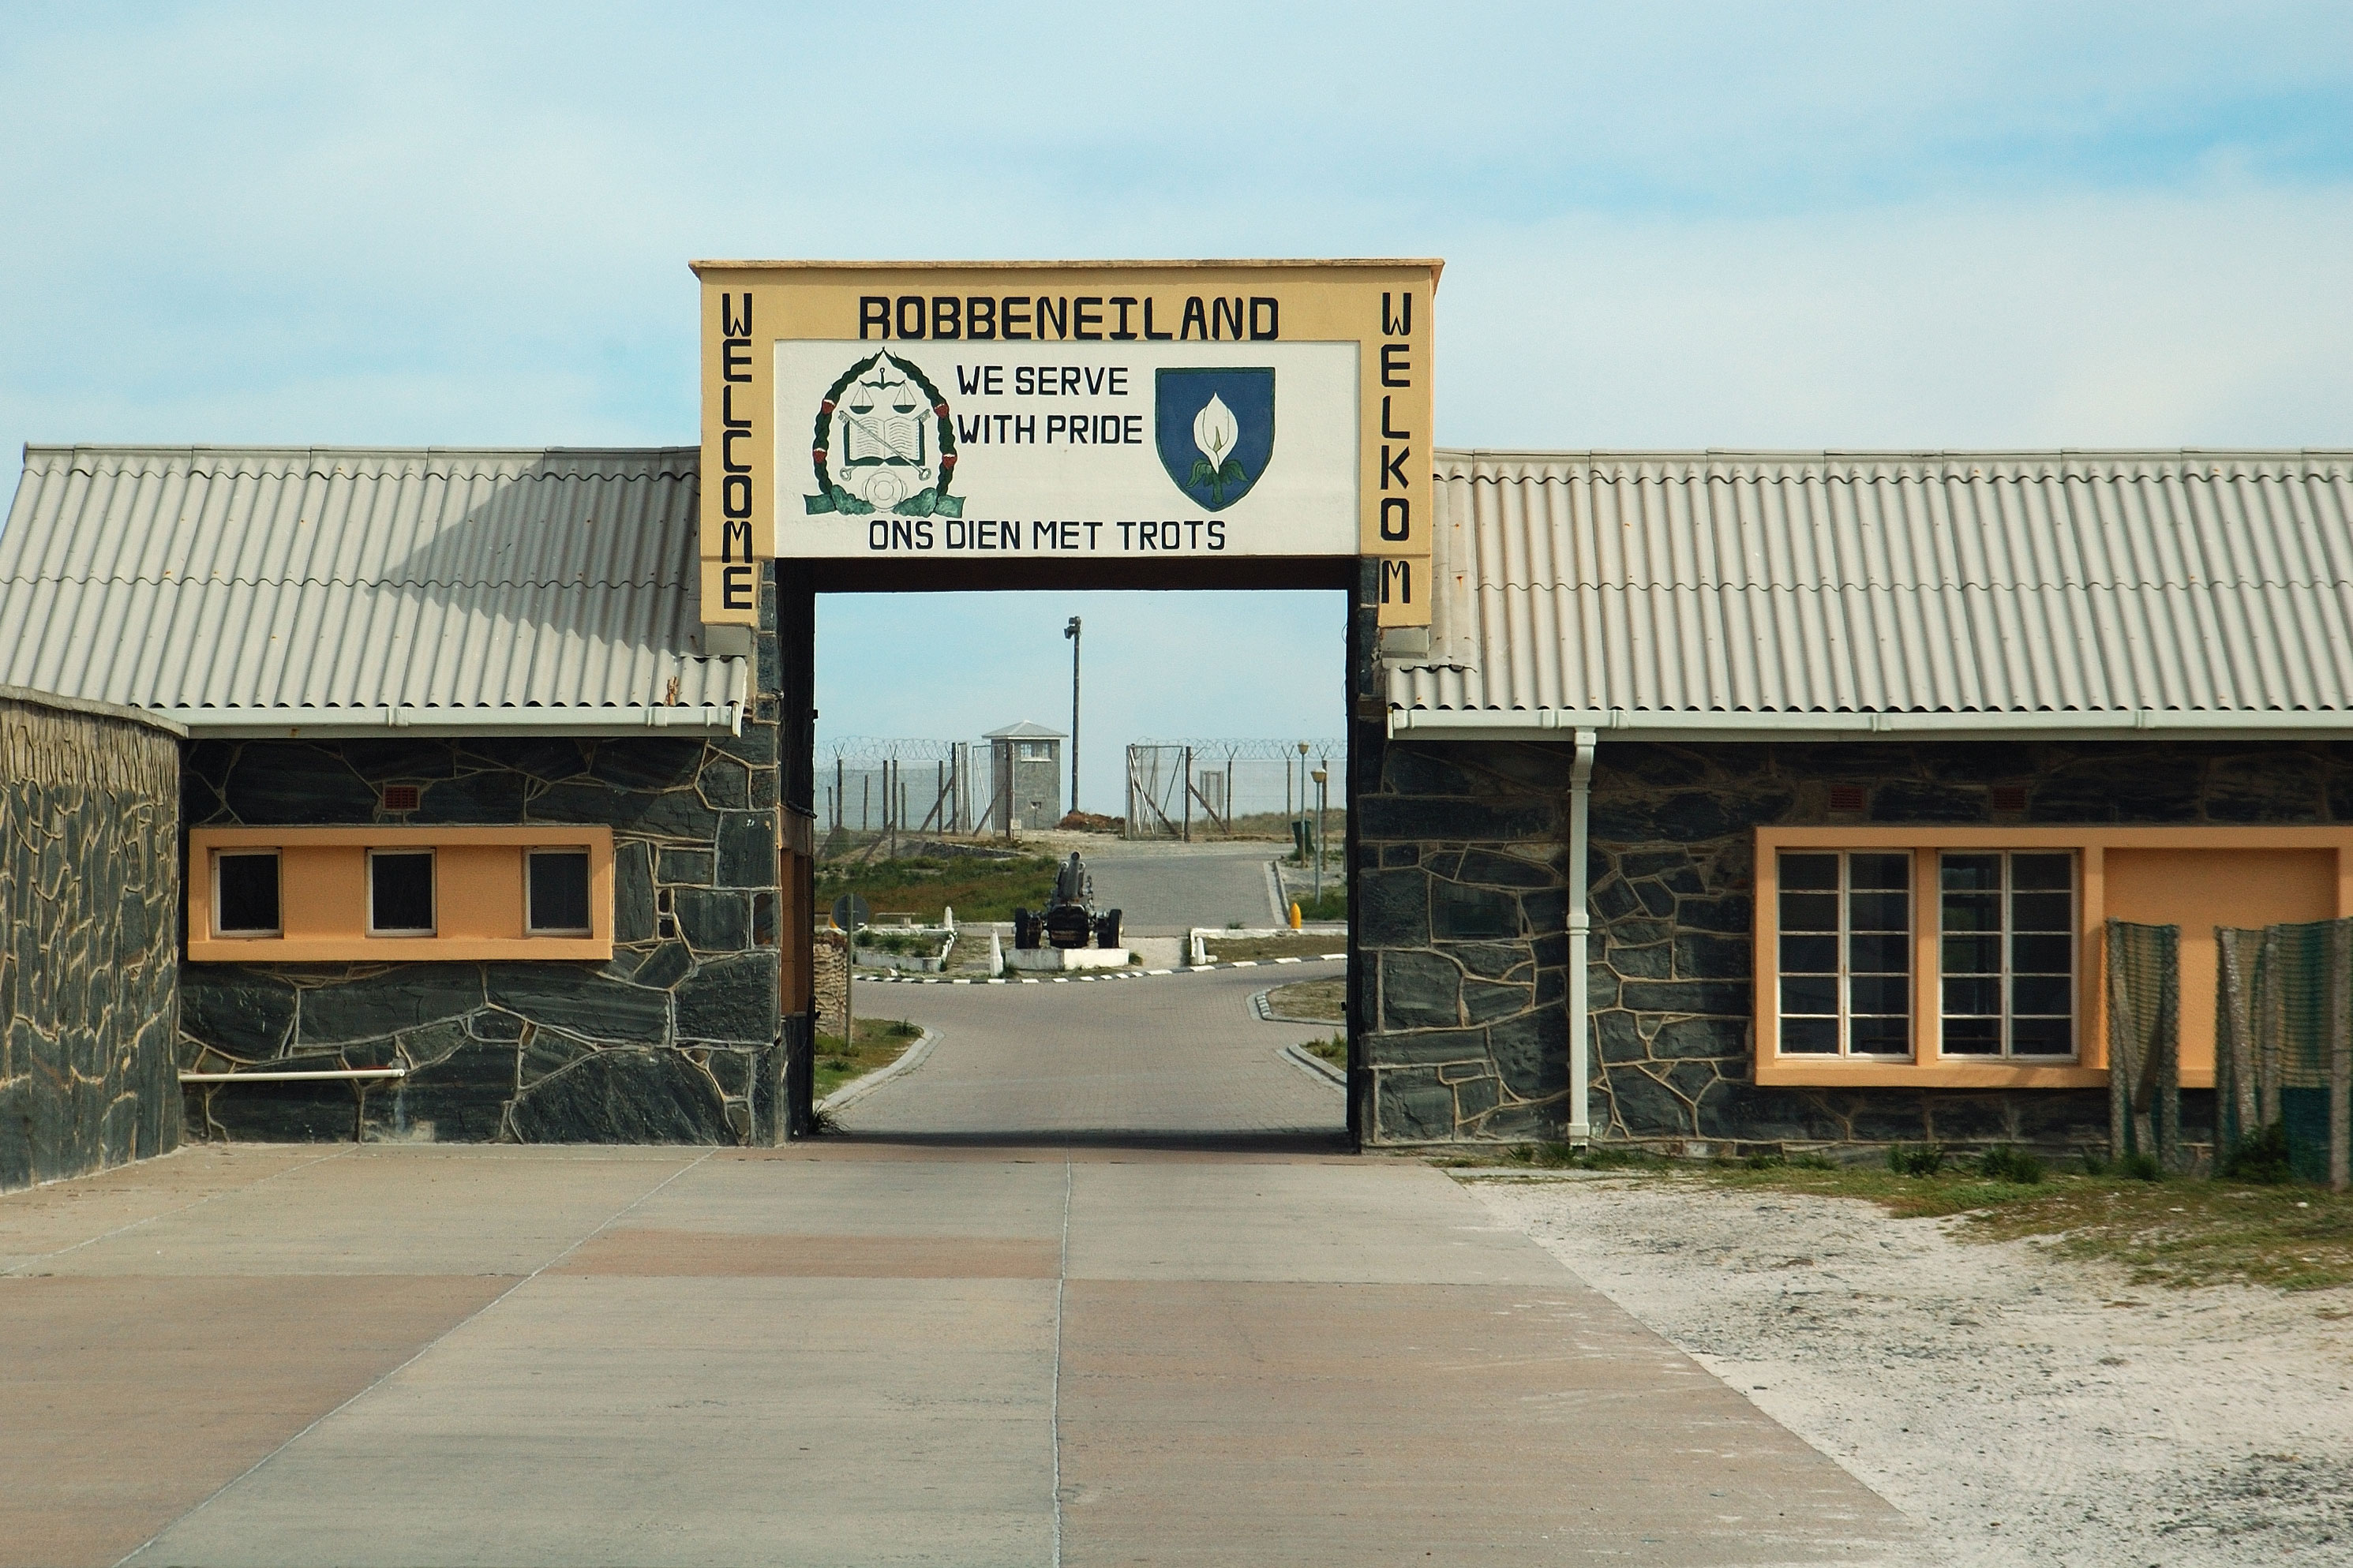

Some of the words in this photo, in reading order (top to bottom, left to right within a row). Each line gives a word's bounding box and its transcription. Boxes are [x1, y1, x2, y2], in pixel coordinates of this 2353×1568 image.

[860, 297, 1278, 340] ROBBENEILAND
[957, 365, 1002, 395] WE
[1016, 367, 1127, 395] SERVE
[957, 415, 1035, 443] WITH
[1047, 415, 1142, 443] PRIDE
[722, 293, 753, 609] WELCOME
[1381, 293, 1411, 604] WELKOM
[870, 521, 933, 549] ONS
[946, 521, 1020, 549] DIEN
[1034, 522, 1103, 549] MET
[1117, 521, 1225, 550] TROTS
